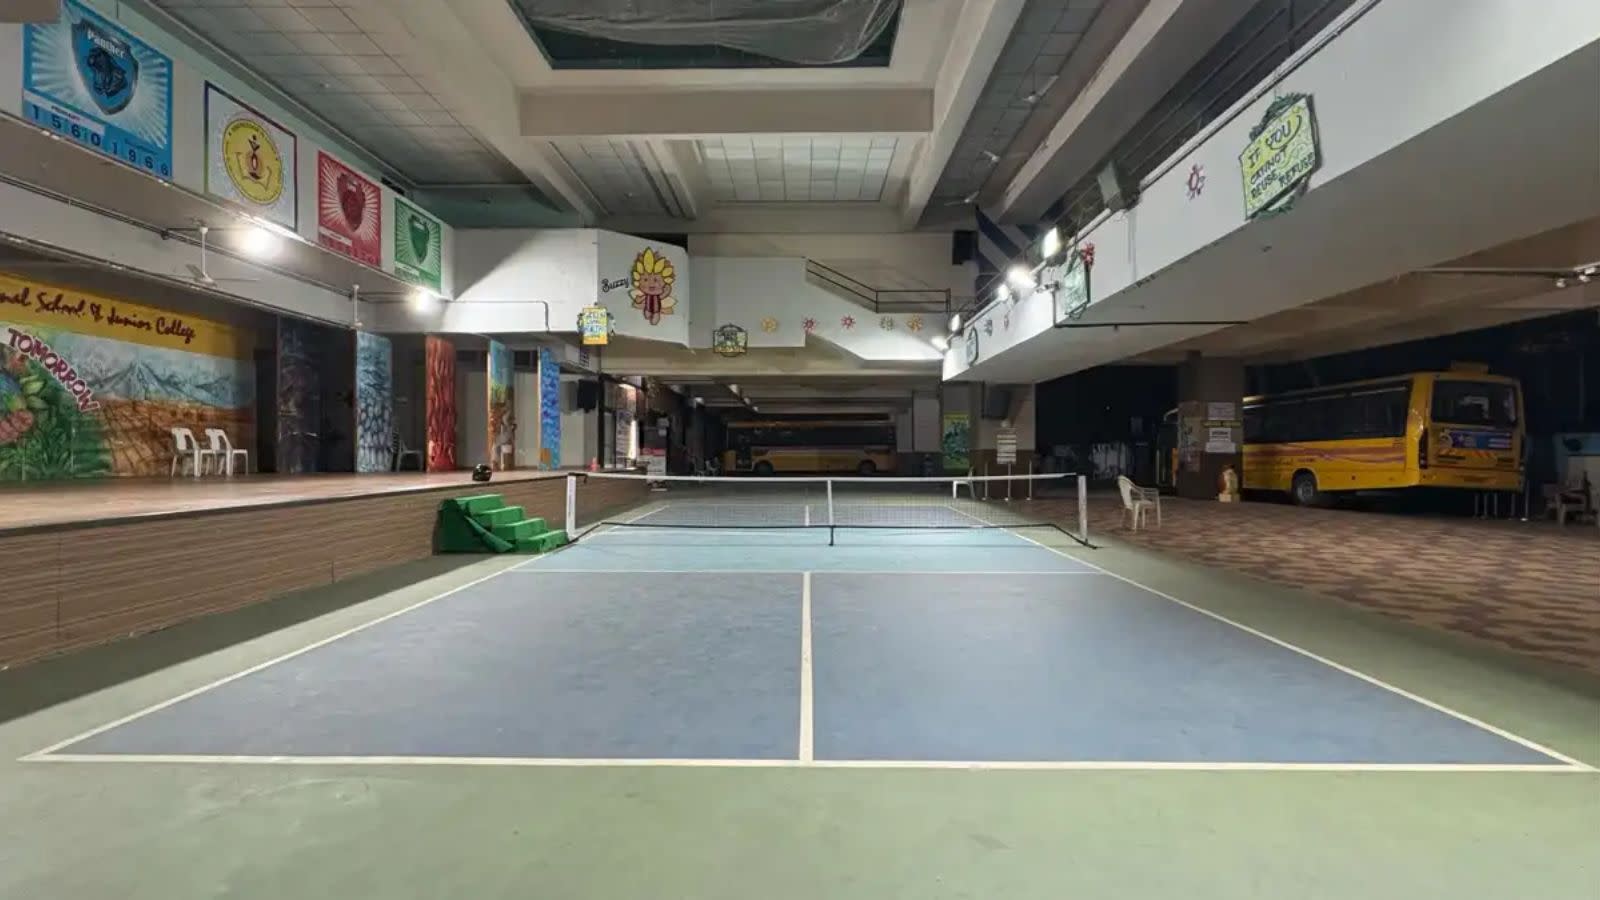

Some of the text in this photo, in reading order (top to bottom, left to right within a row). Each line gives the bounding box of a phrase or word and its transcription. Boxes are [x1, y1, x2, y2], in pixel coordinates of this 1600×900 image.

[87, 28, 125, 58] Panther
[601, 278, 630, 293] Buzzy
[107, 307, 152, 330] Junior
[8, 327, 100, 412] TOMORROW
